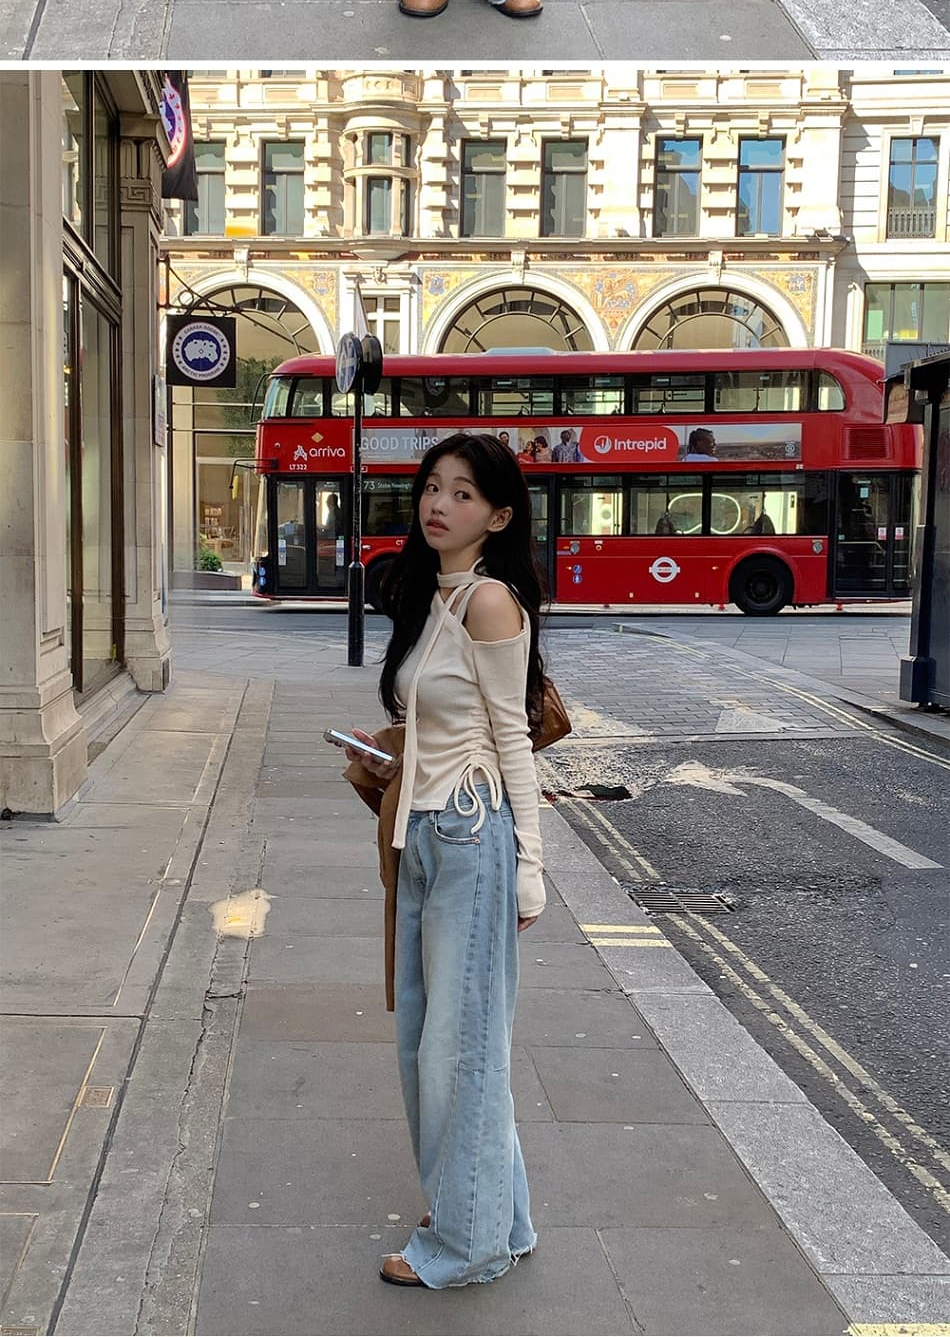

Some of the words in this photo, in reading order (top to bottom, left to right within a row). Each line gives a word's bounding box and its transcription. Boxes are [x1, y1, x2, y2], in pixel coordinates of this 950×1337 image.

[361, 436, 400, 451] GOOD
[614, 437, 667, 453] Intrepid
[309, 445, 346, 458] arriva
[363, 480, 376, 491] 73
